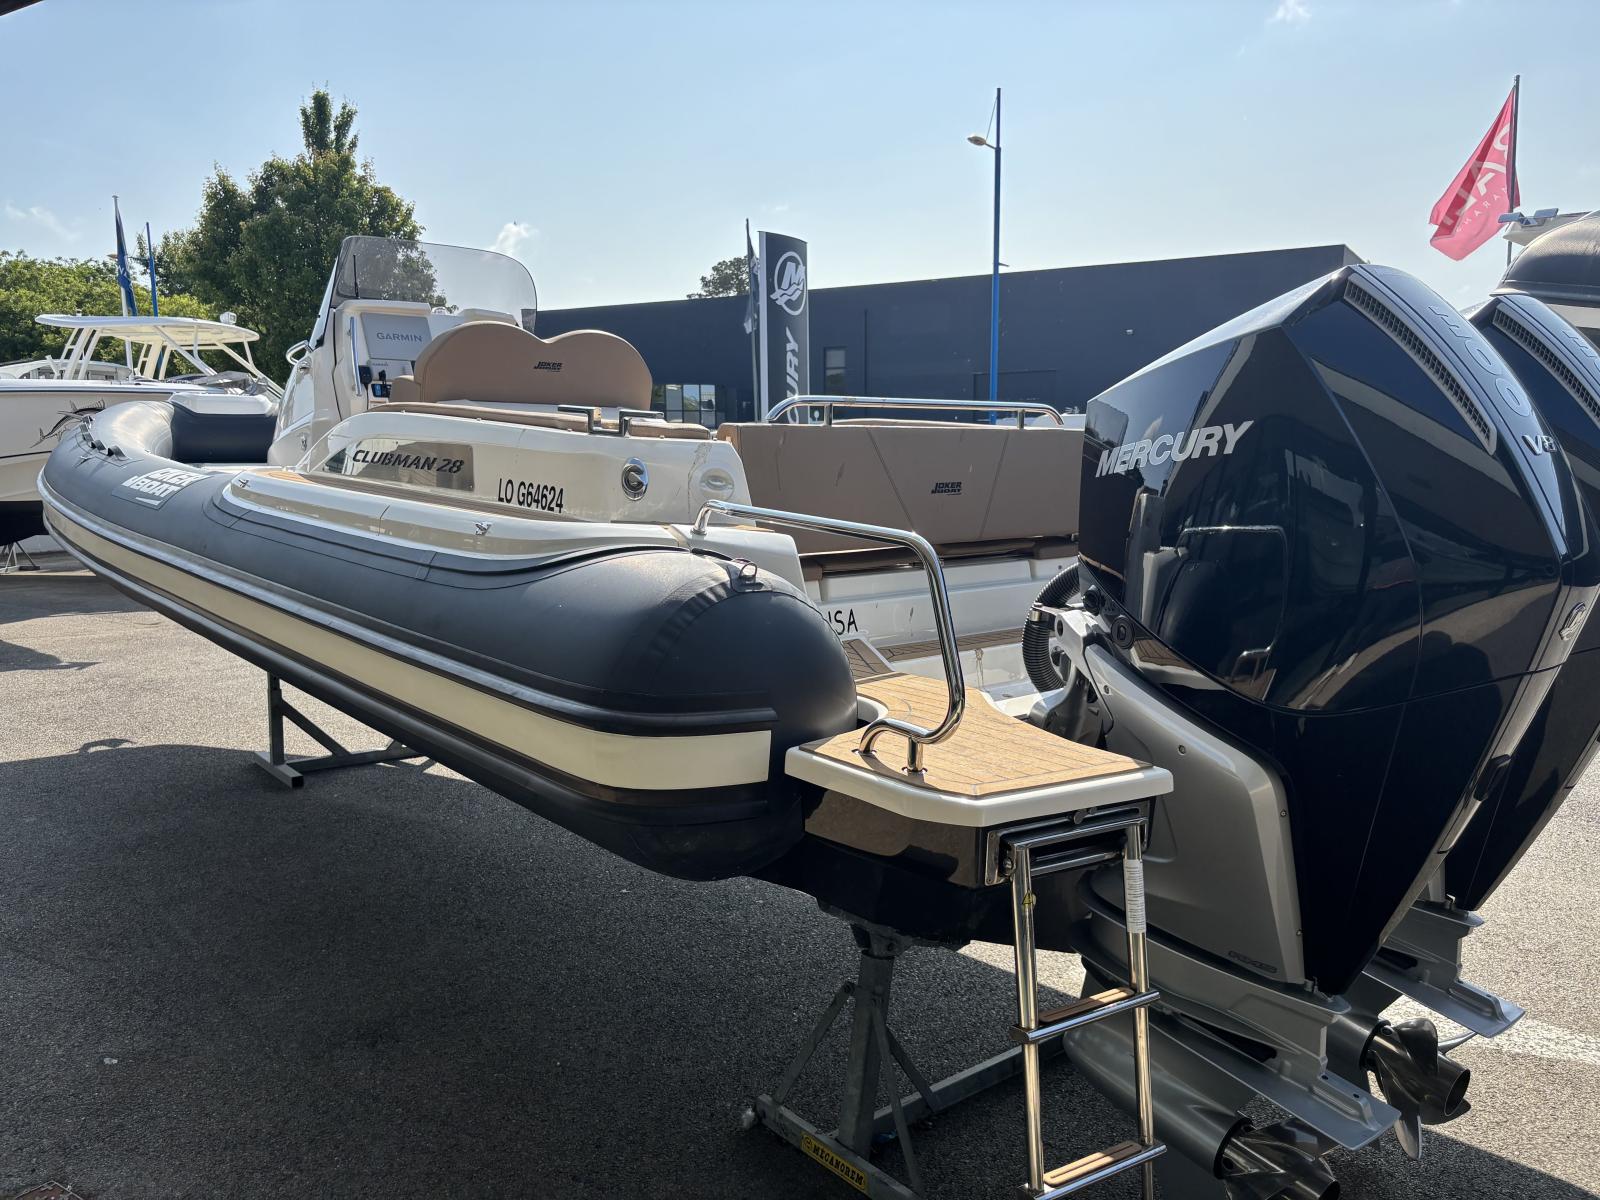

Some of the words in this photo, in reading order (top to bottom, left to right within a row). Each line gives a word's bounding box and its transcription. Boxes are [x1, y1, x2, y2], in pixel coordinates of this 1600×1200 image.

[376, 332, 423, 342] GARMIN
[352, 449, 437, 471] CLUBMAN
[436, 458, 465, 474] 28
[1096, 420, 1254, 478] MERCURY
[129, 477, 182, 498] BOAT
[497, 478, 513, 504] LO
[517, 480, 564, 514] G64624
